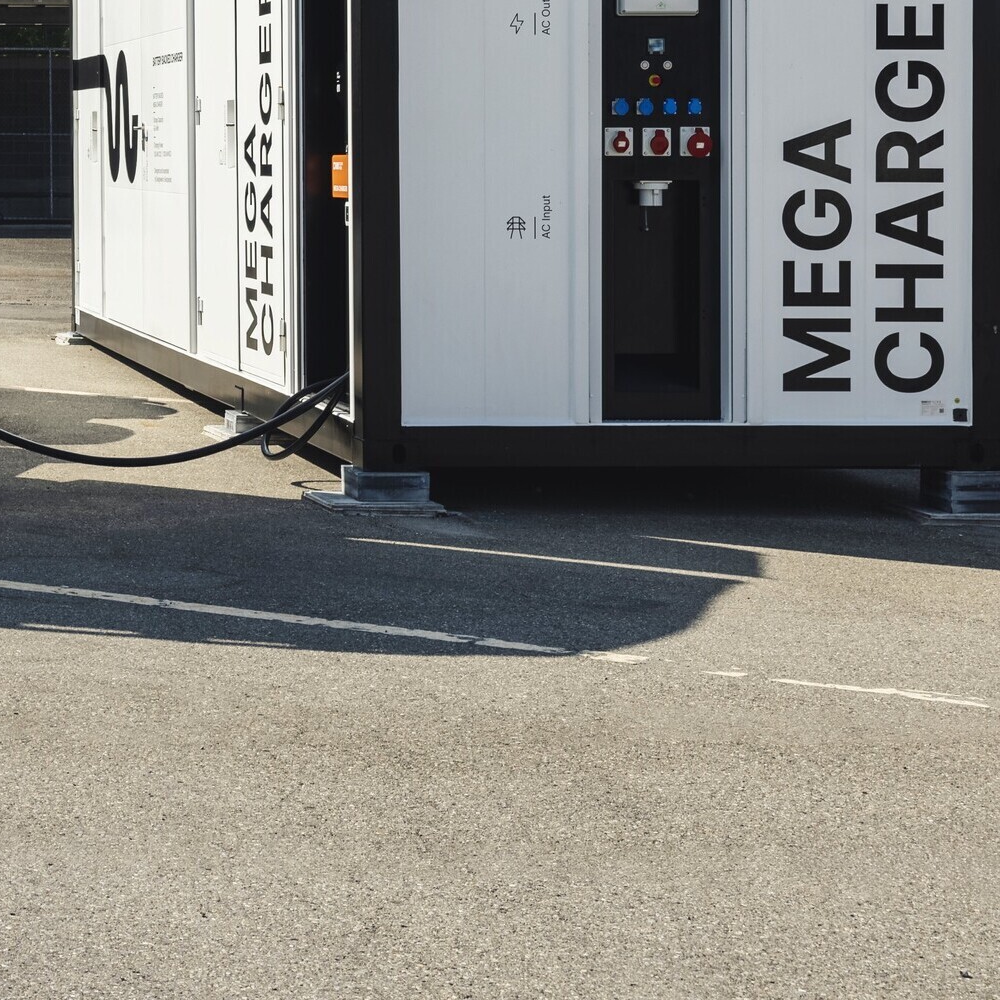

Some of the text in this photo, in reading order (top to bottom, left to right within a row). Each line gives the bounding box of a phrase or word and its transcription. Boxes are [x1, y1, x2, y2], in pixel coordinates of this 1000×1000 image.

[541, 20, 551, 36] AC
[244, 123, 258, 352] MEGA
[541, 194, 553, 239] AC Input
[782, 118, 852, 392] MEGA
